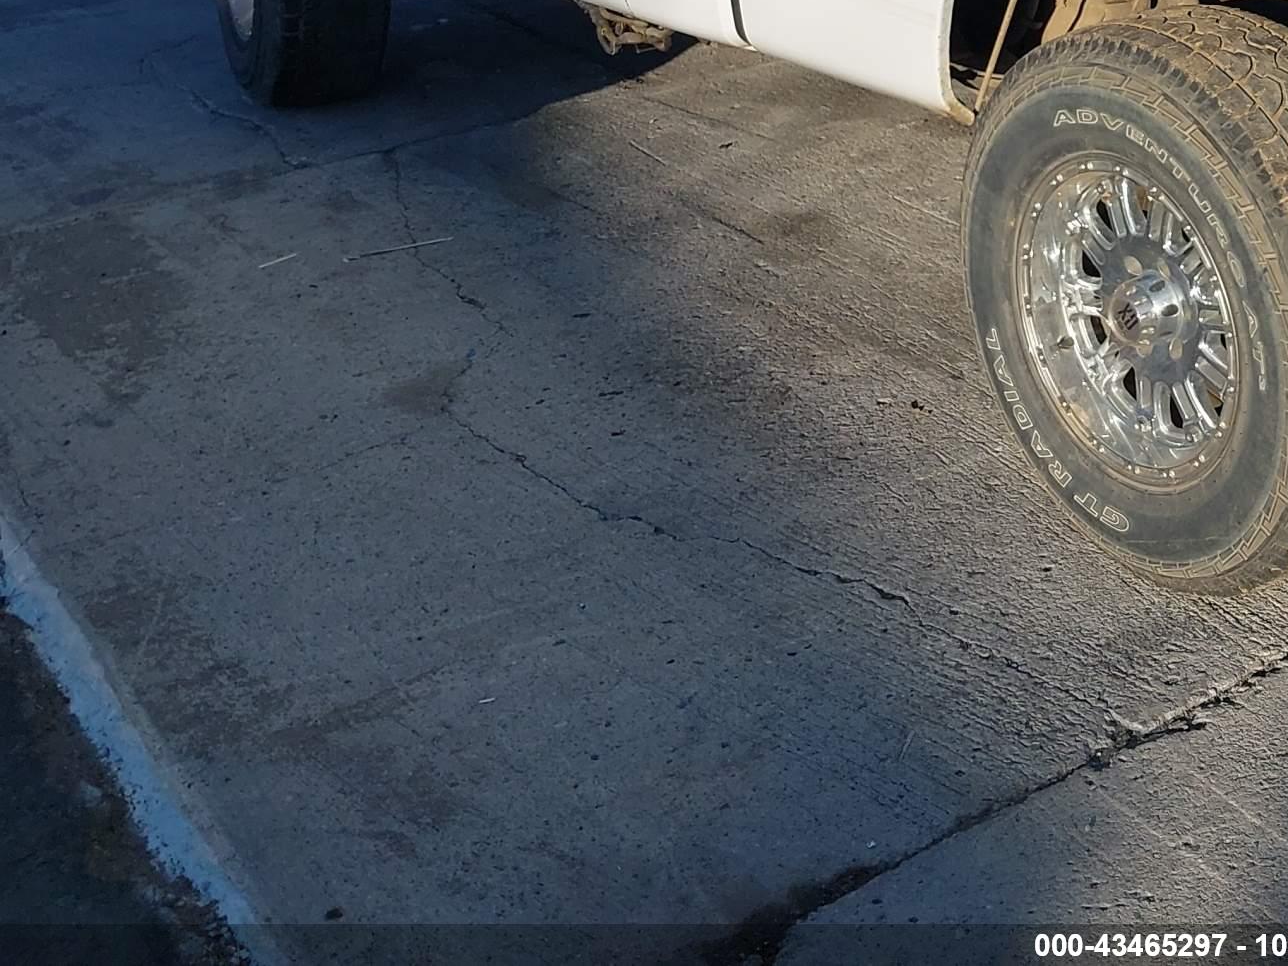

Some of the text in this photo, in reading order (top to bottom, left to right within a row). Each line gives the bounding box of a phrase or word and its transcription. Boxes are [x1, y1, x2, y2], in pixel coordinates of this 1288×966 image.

[1052, 108, 1247, 289] ADVENTURO
[985, 328, 1130, 532] GT RADIAL
